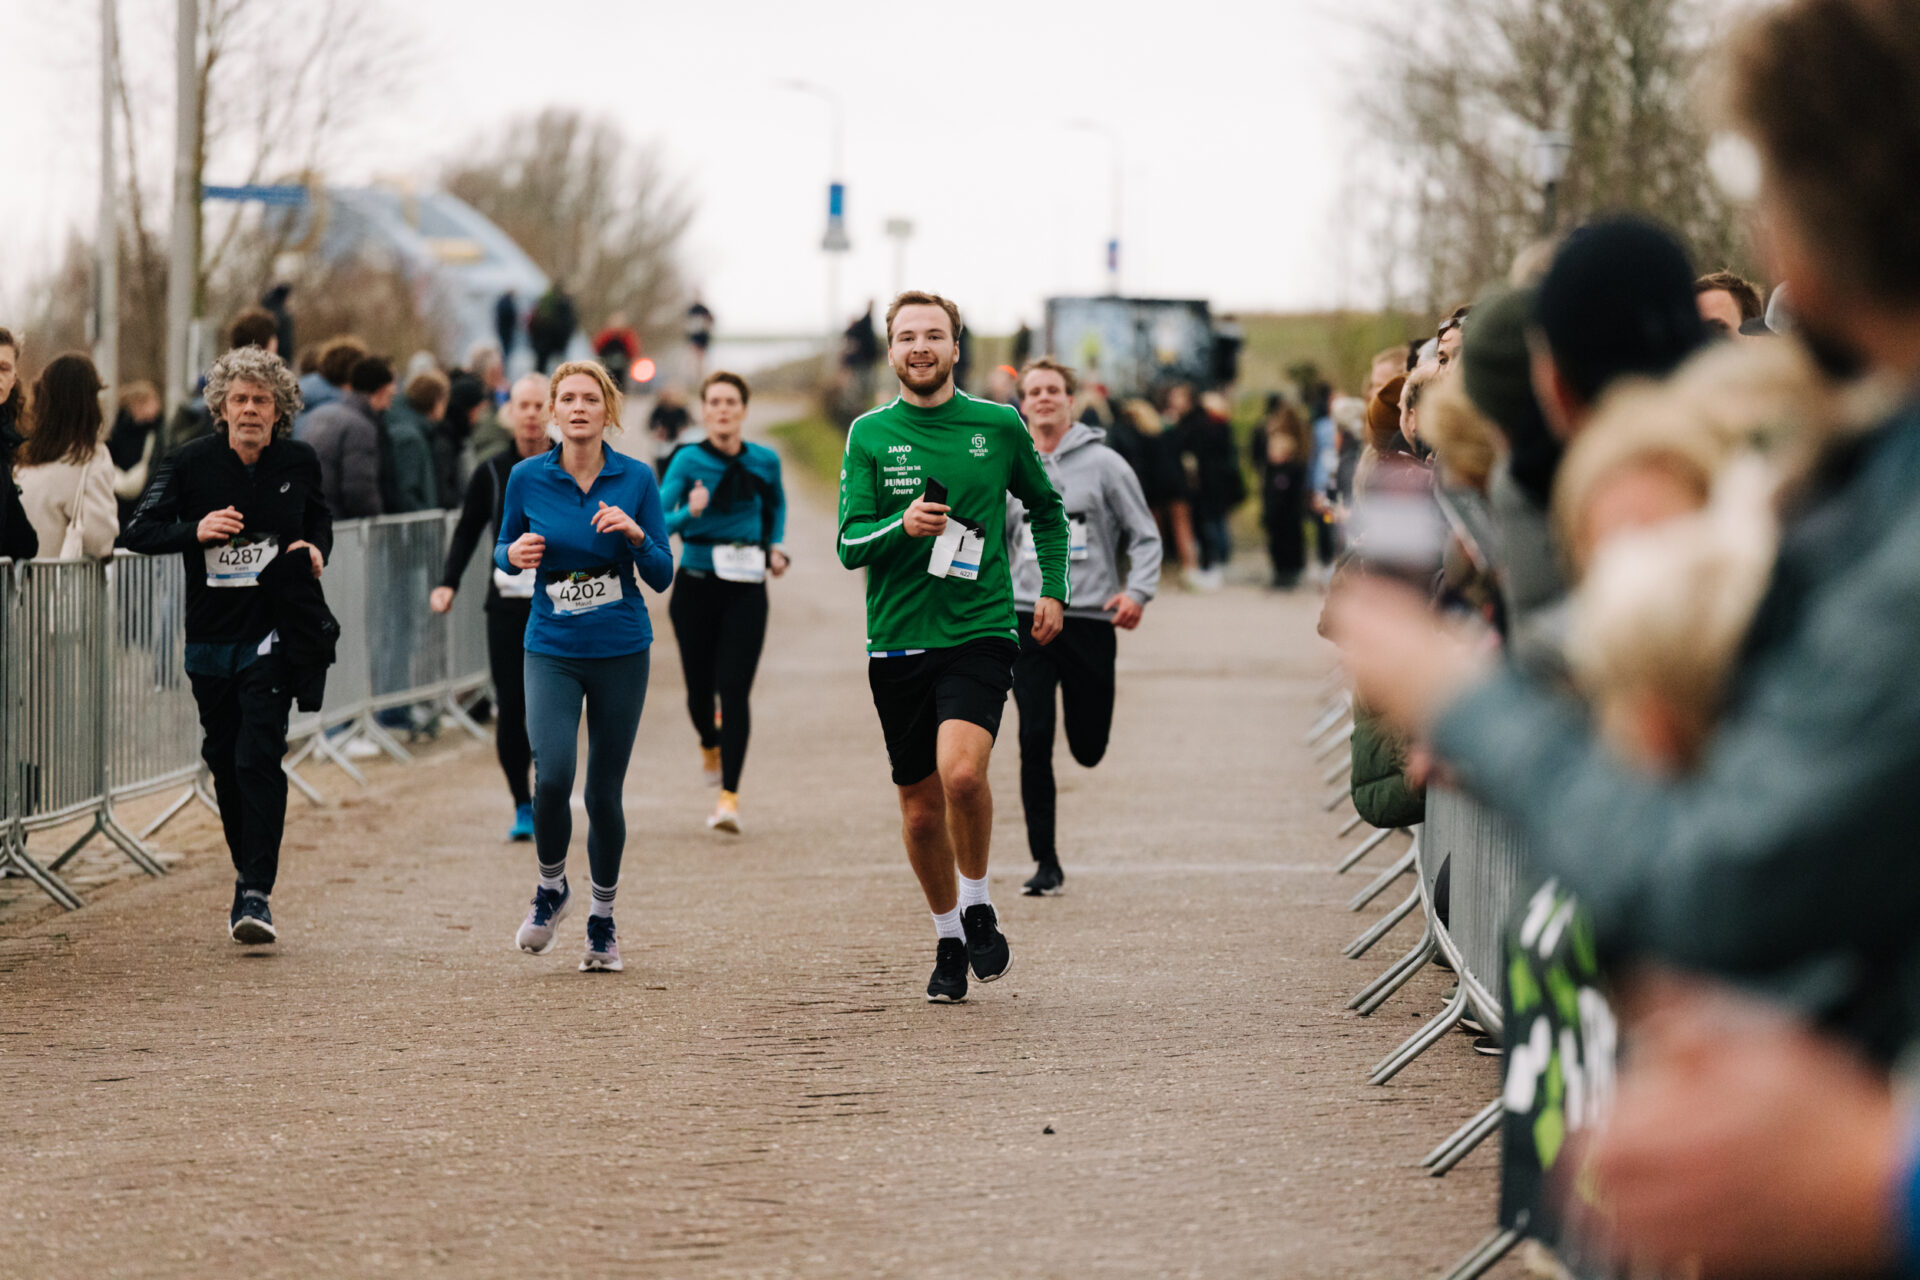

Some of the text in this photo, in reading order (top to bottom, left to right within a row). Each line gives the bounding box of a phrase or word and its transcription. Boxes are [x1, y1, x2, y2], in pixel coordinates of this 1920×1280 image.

[888, 445, 912, 453] JAKO
[884, 477, 922, 487] JUMBO
[892, 487, 914, 496] Joure
[218, 548, 264, 567] 4287
[560, 581, 606, 602] 4202
